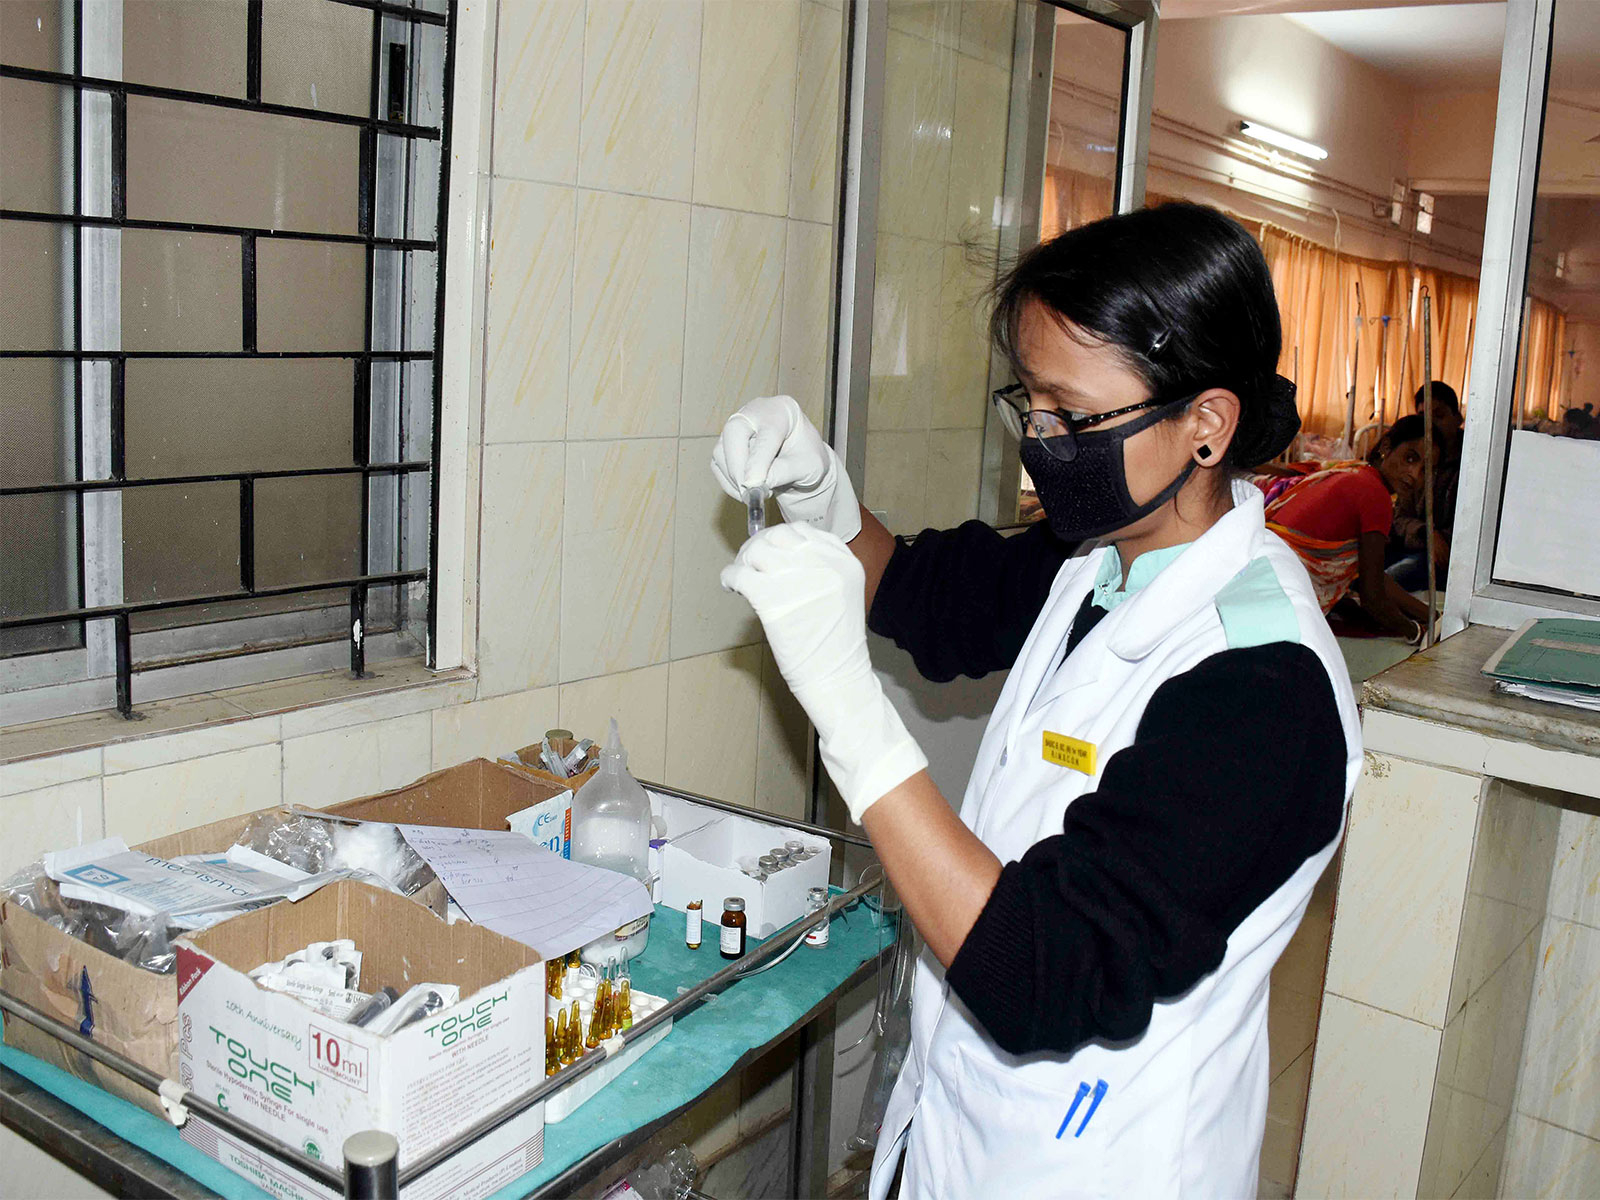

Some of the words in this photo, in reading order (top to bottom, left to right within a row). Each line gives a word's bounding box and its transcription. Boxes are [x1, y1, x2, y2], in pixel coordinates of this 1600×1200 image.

[246, 1010, 302, 1051] Anniversary
[424, 991, 508, 1037] TOUCH
[442, 1013, 492, 1046] ONE
[209, 1025, 315, 1097] TOUCH
[466, 1034, 489, 1049] NEEDLE
[206, 1059, 223, 1076] Sterile
[223, 1071, 259, 1096] Hypodermic
[259, 1091, 283, 1112] Syringe
[283, 1104, 295, 1115] For
[296, 1111, 315, 1128] single
[316, 1123, 329, 1134] use
[228, 1057, 293, 1104] ONE
[243, 1093, 260, 1107] WITH
[260, 1102, 286, 1122] NEEDLE
[229, 1154, 267, 1181] TOSHIBA
